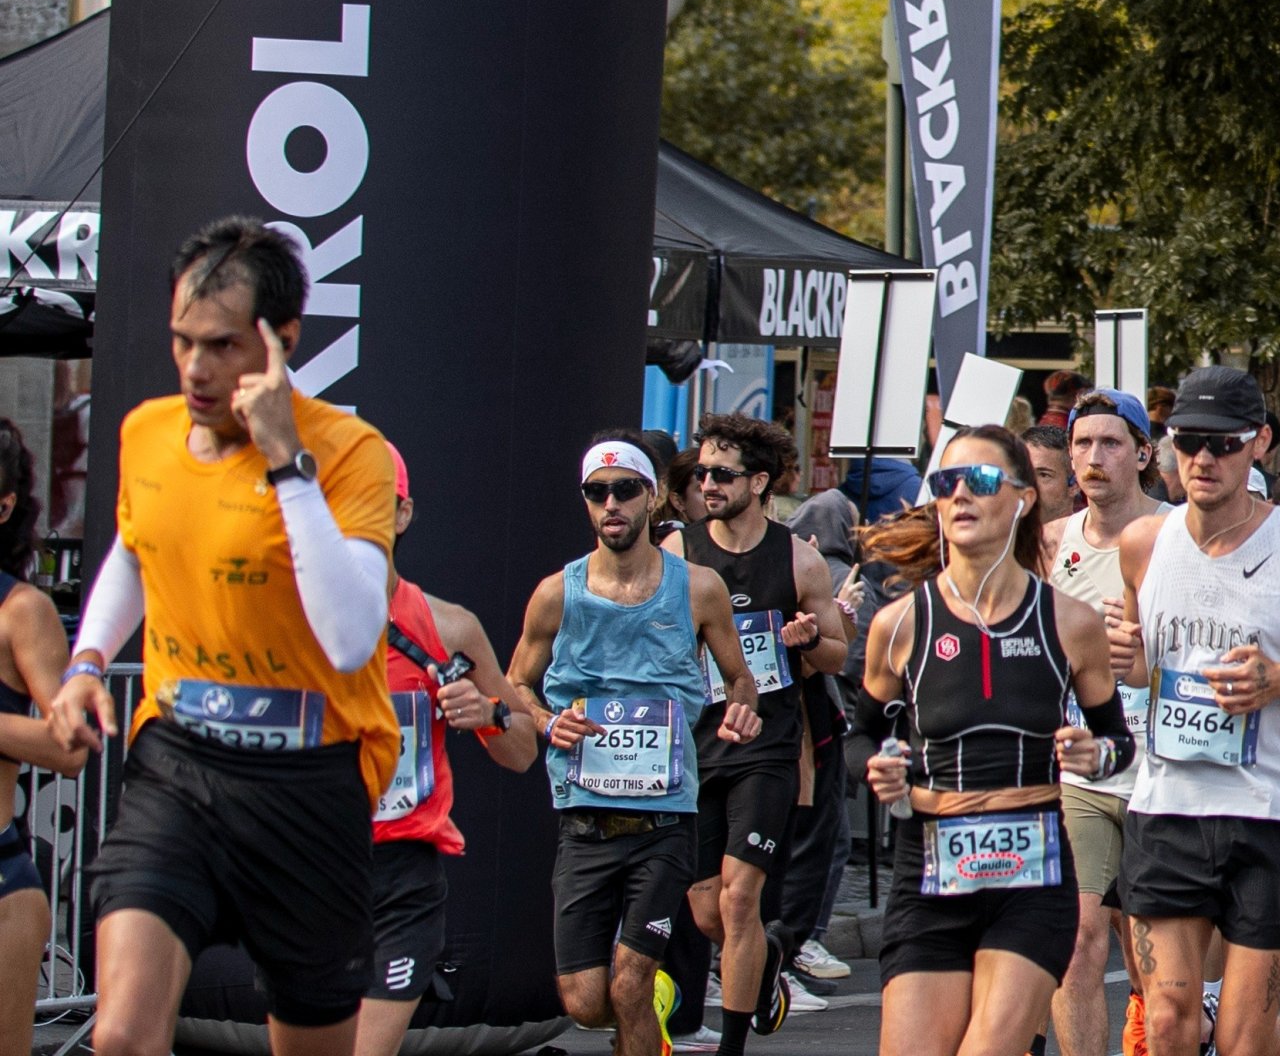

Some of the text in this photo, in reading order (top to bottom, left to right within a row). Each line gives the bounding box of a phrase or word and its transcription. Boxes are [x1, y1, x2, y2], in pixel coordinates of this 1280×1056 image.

[1126, 715, 1140, 726] HIS
[1161, 705, 1236, 735] 29464
[594, 729, 659, 749] 26512
[1178, 734, 1210, 748] Ruben
[613, 753, 638, 761] assaf
[582, 777, 644, 790] YOU GOT THIS
[949, 826, 1032, 857] 61435
[969, 858, 1013, 873] Claudia
